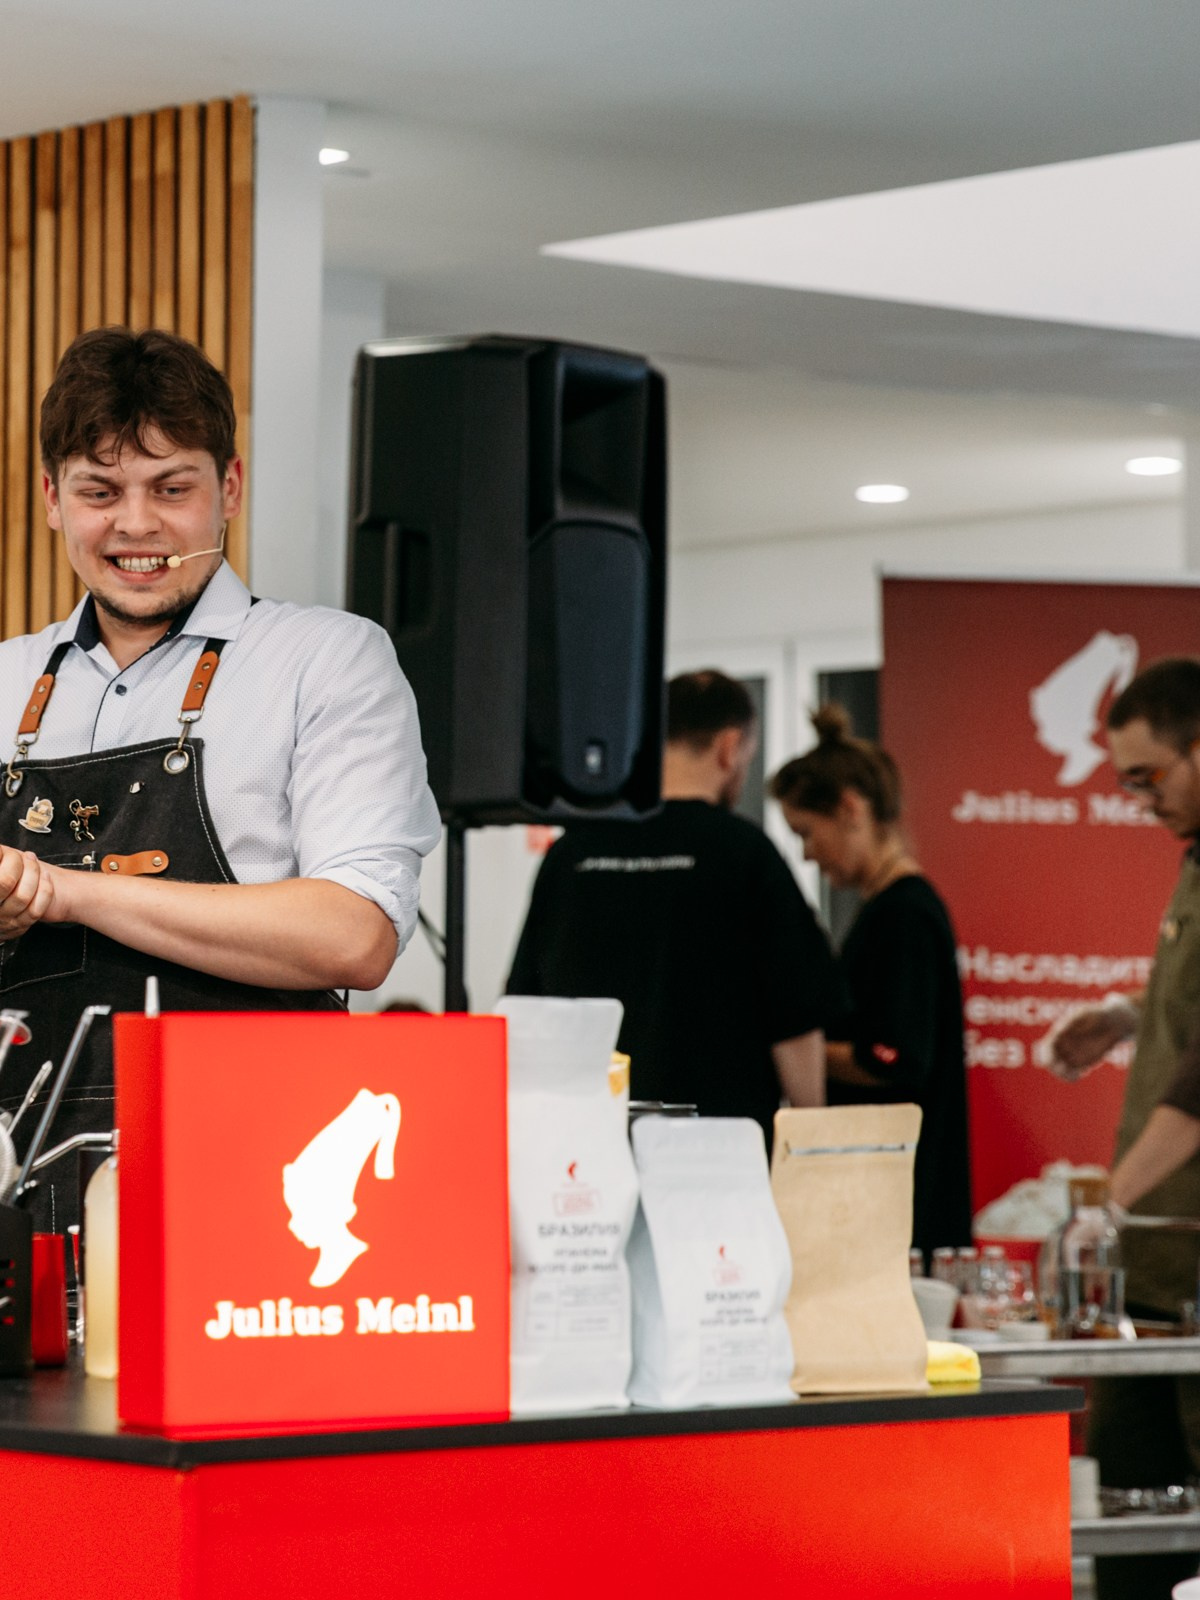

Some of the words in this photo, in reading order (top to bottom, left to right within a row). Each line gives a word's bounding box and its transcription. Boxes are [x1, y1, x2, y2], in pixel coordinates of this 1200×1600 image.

[952, 790, 1079, 824] Julius
[204, 1297, 344, 1340] Julius
[356, 1294, 475, 1334] Meinl
